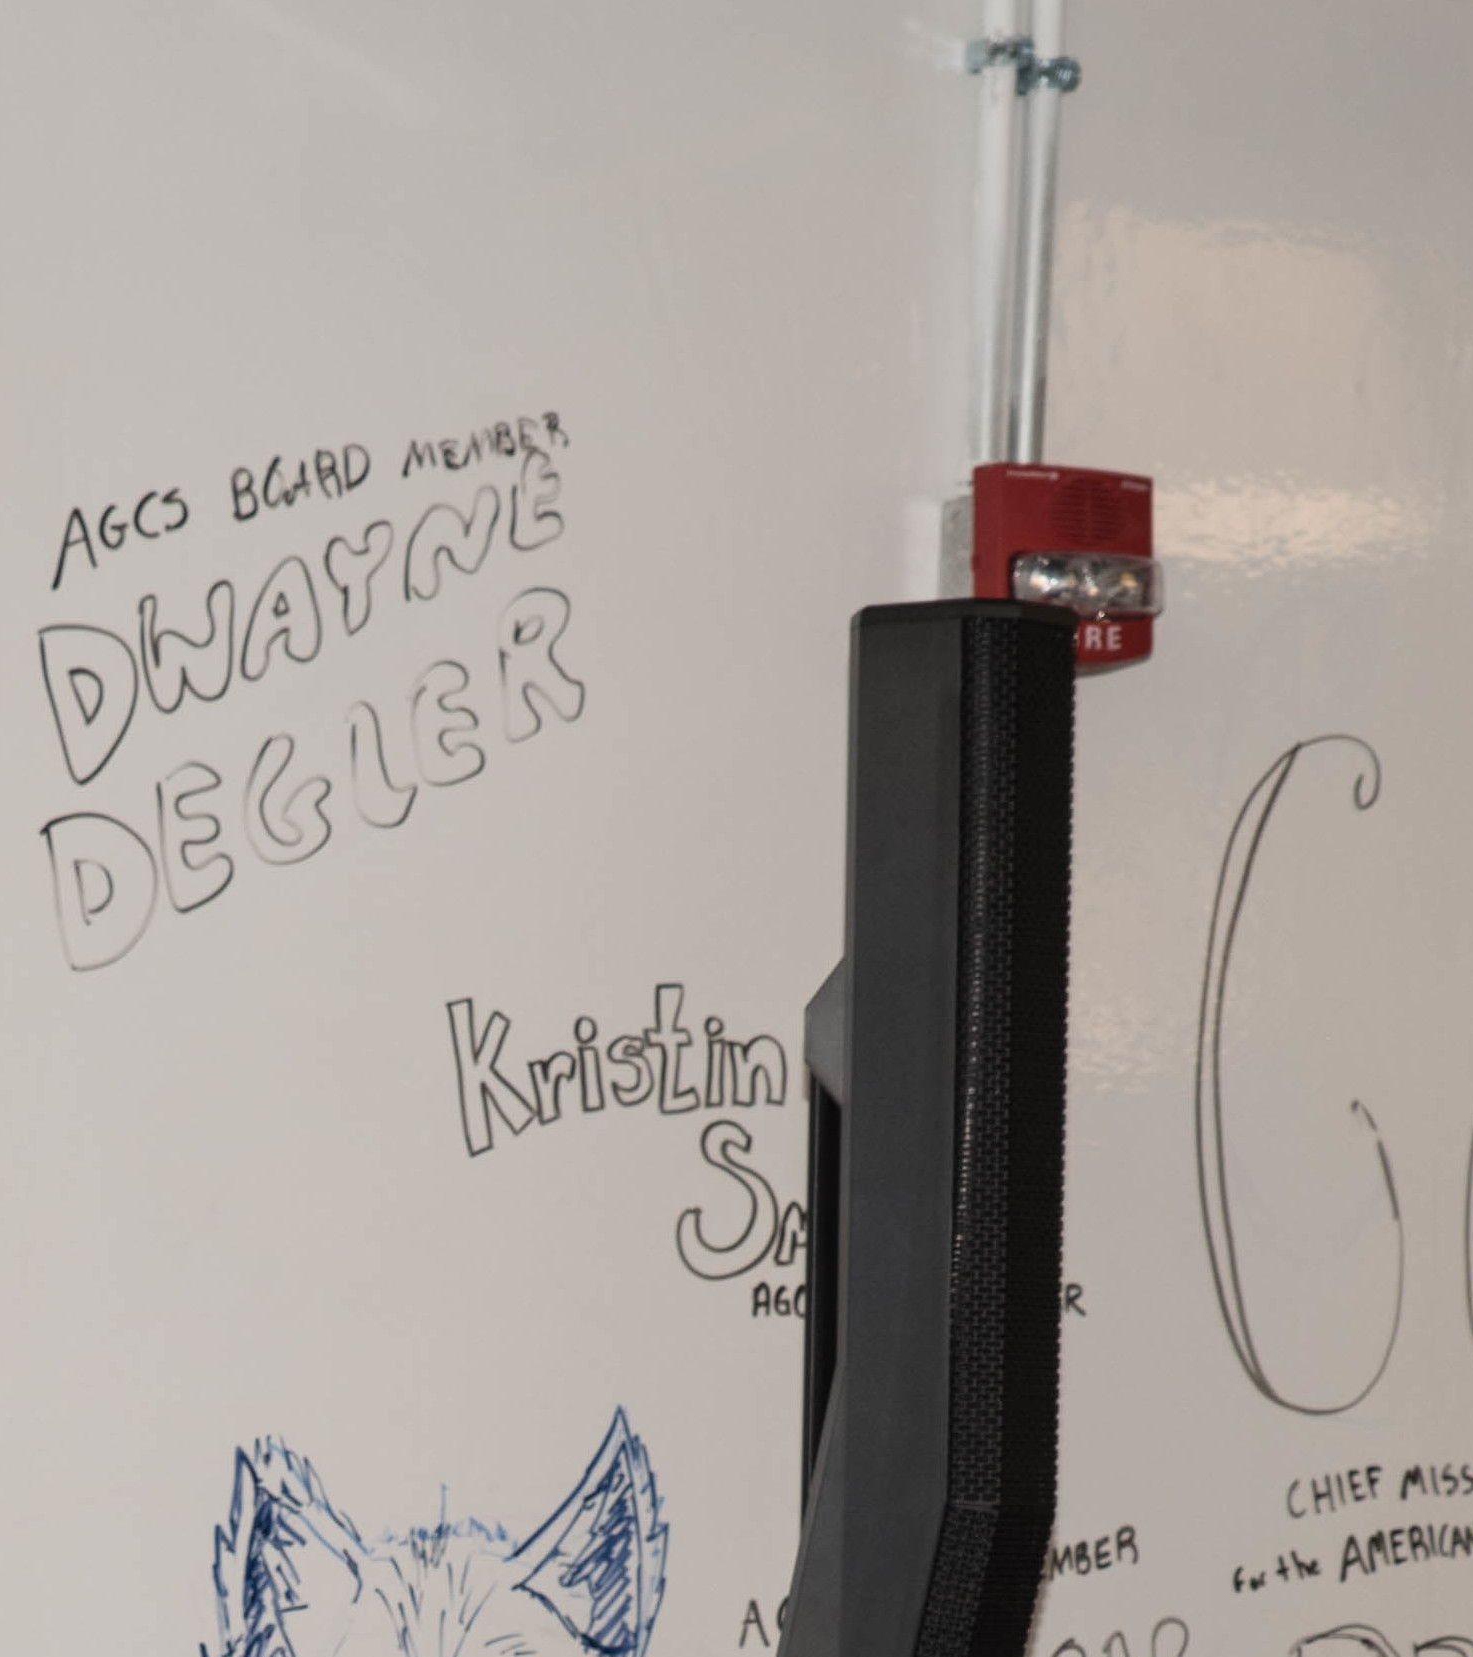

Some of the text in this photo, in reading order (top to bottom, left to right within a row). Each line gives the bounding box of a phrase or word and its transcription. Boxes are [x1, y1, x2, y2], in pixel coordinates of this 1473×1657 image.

[51, 488, 189, 591] AGCS
[401, 411, 570, 479] MEMBER
[37, 449, 566, 786] DWAYNE
[1073, 624, 1123, 651] RE
[39, 587, 585, 972] DEGLER
[446, 983, 788, 1157] Kristin
[1286, 1464, 1383, 1519] CHIEF
[1041, 1524, 1140, 1581] MBER
[1276, 1550, 1321, 1583] the
